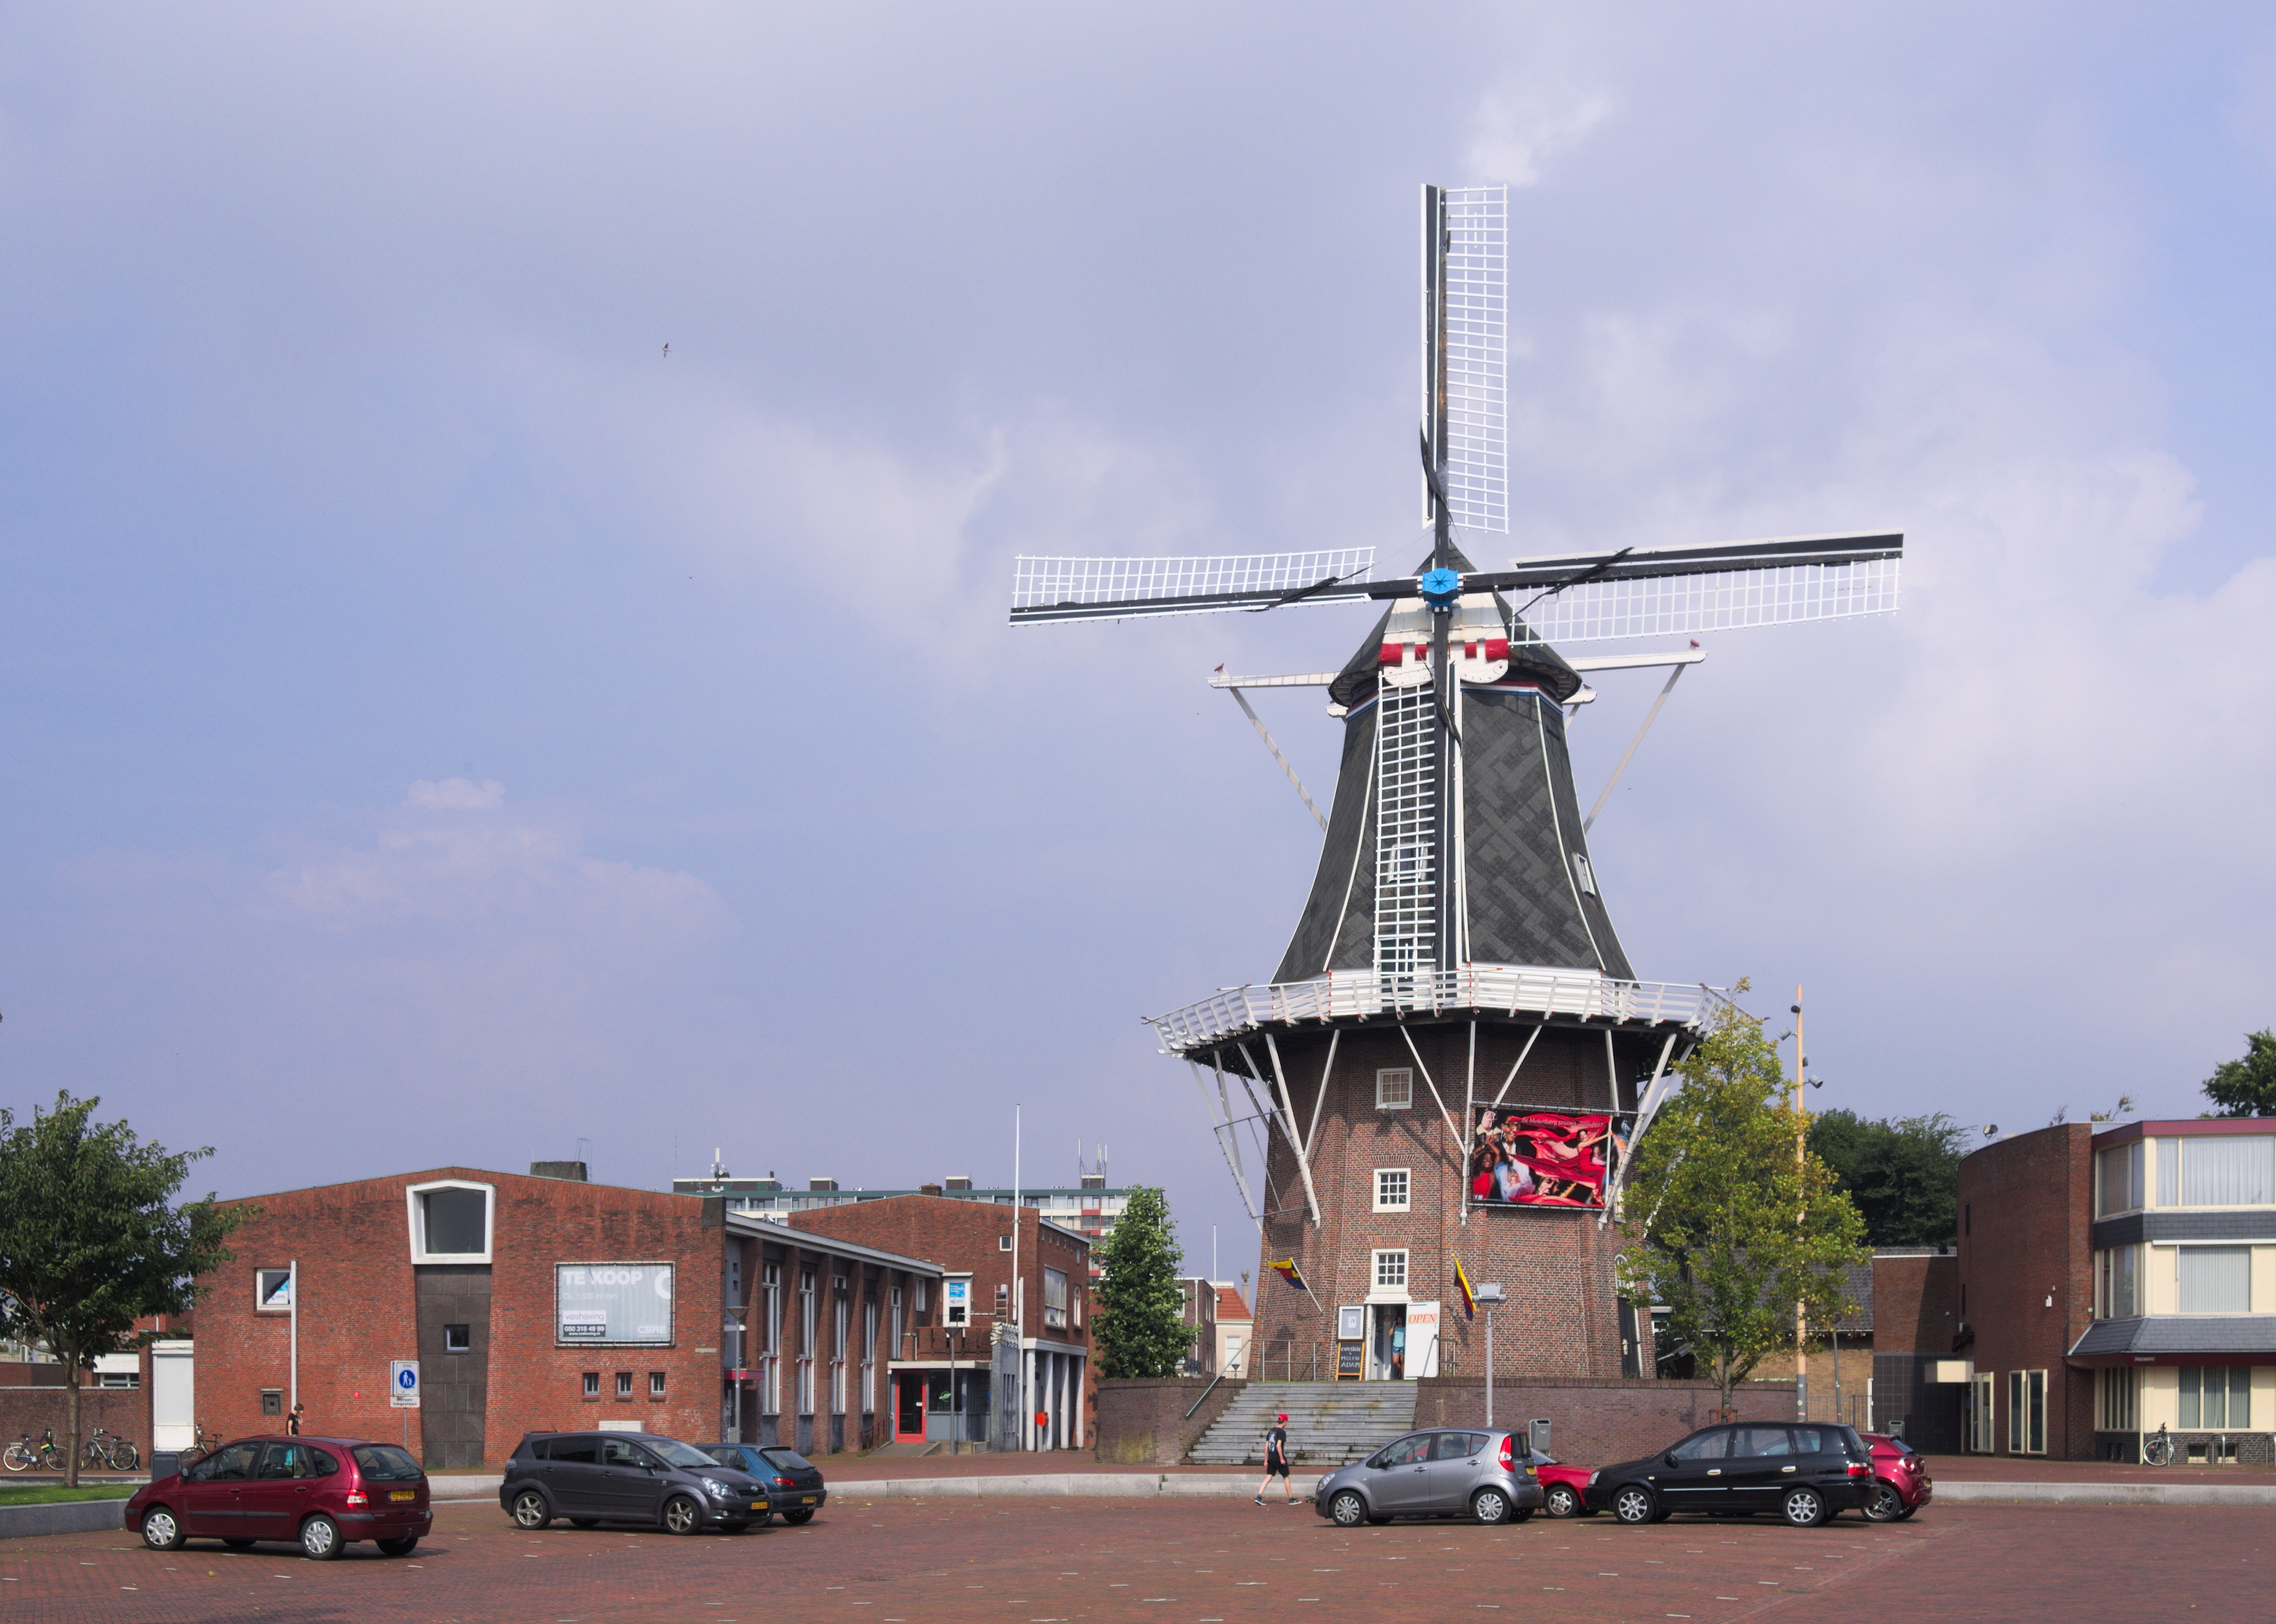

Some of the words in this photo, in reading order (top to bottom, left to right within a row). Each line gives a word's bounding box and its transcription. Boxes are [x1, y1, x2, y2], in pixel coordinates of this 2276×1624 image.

[1529, 1117, 1558, 1126] Molenberg
[563, 1271, 585, 1285] TE
[591, 1271, 643, 1285] KOOP
[565, 1312, 604, 1321] voshoving
[1408, 1314, 1437, 1324] OPEN
